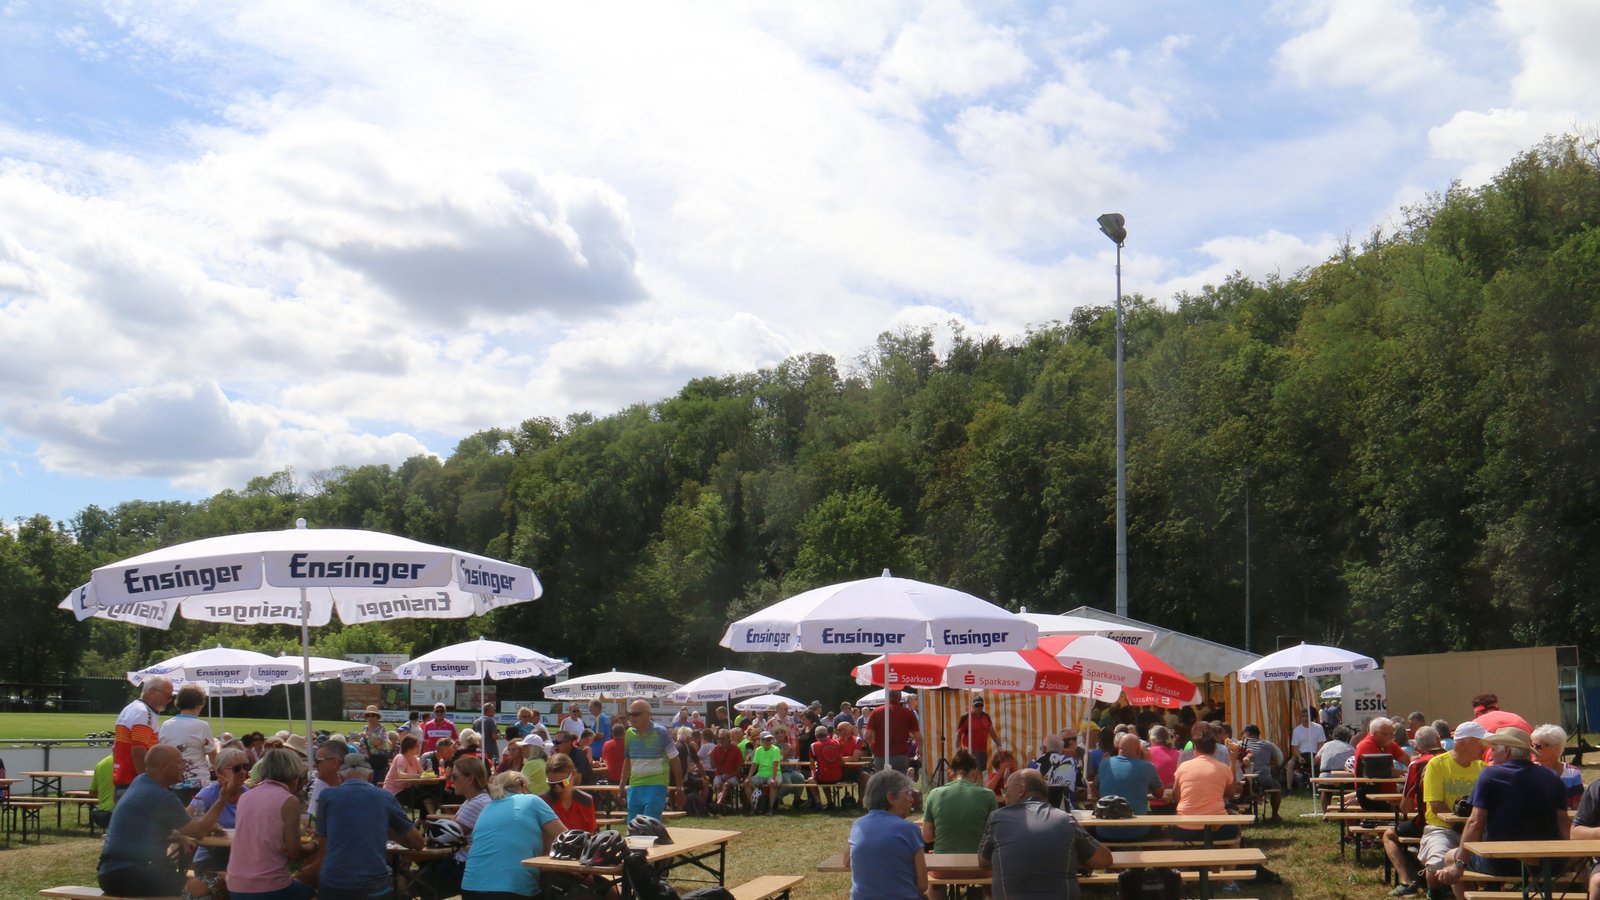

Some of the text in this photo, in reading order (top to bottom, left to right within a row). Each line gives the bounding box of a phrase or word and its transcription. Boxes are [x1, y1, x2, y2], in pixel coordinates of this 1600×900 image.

[288, 552, 427, 585] Ensinger
[124, 564, 243, 594] Ensinger
[746, 628, 791, 647] Ensinger
[821, 627, 907, 647] Ensinger
[943, 629, 1010, 648] Ensinger
[196, 668, 241, 679] Ensinger
[257, 667, 290, 679] Ensinger
[430, 663, 471, 673] Ensinger
[1309, 664, 1343, 674] Ensinger
[901, 673, 935, 685] Sparkasse
[1086, 669, 1127, 683] Sparkasse
[1264, 671, 1296, 679] Ensinger
[581, 683, 621, 692] Ensinger
[633, 681, 667, 691] Ensinger
[979, 677, 1022, 688] Sparkasse
[1045, 680, 1071, 692] Sparkasse
[1154, 684, 1181, 699] Sparkasse
